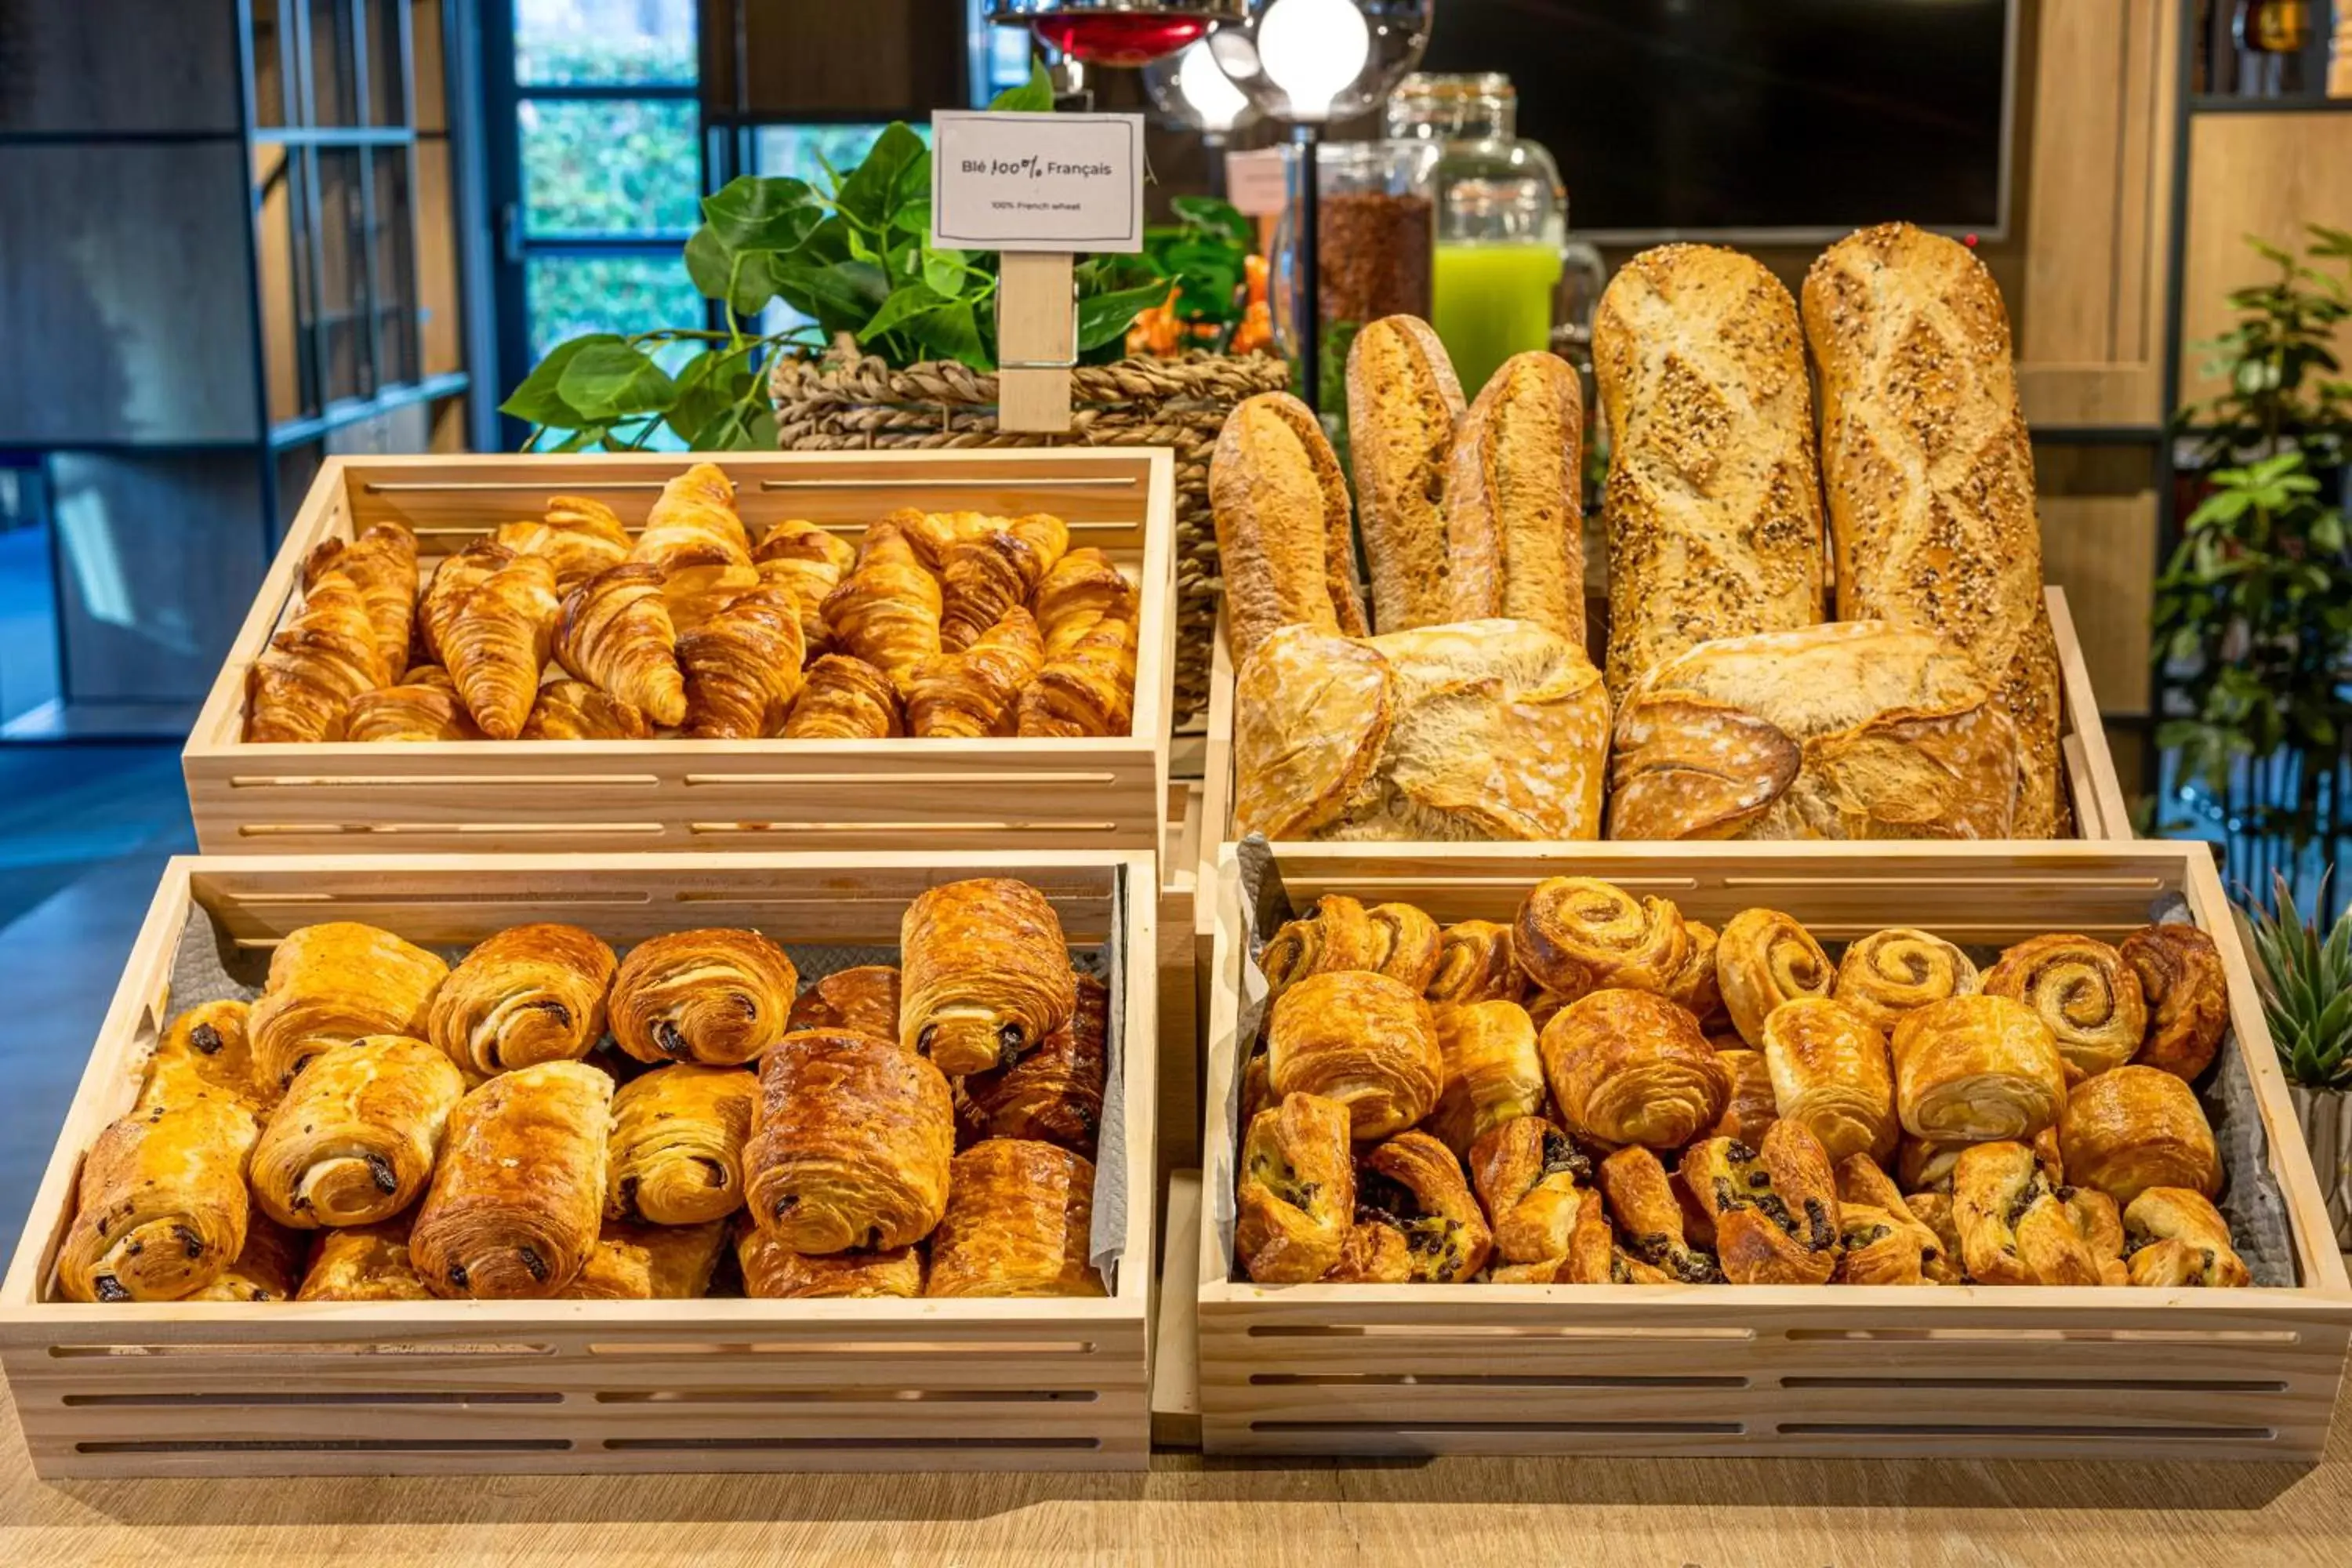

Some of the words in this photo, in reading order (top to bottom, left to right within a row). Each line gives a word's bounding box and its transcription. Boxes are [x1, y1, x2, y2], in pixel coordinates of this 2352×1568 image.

[962, 160, 985, 173] Blé
[991, 155, 1043, 179] 100%
[1047, 162, 1112, 178] Français
[1018, 201, 1049, 210] French
[1052, 201, 1081, 210] wheat
